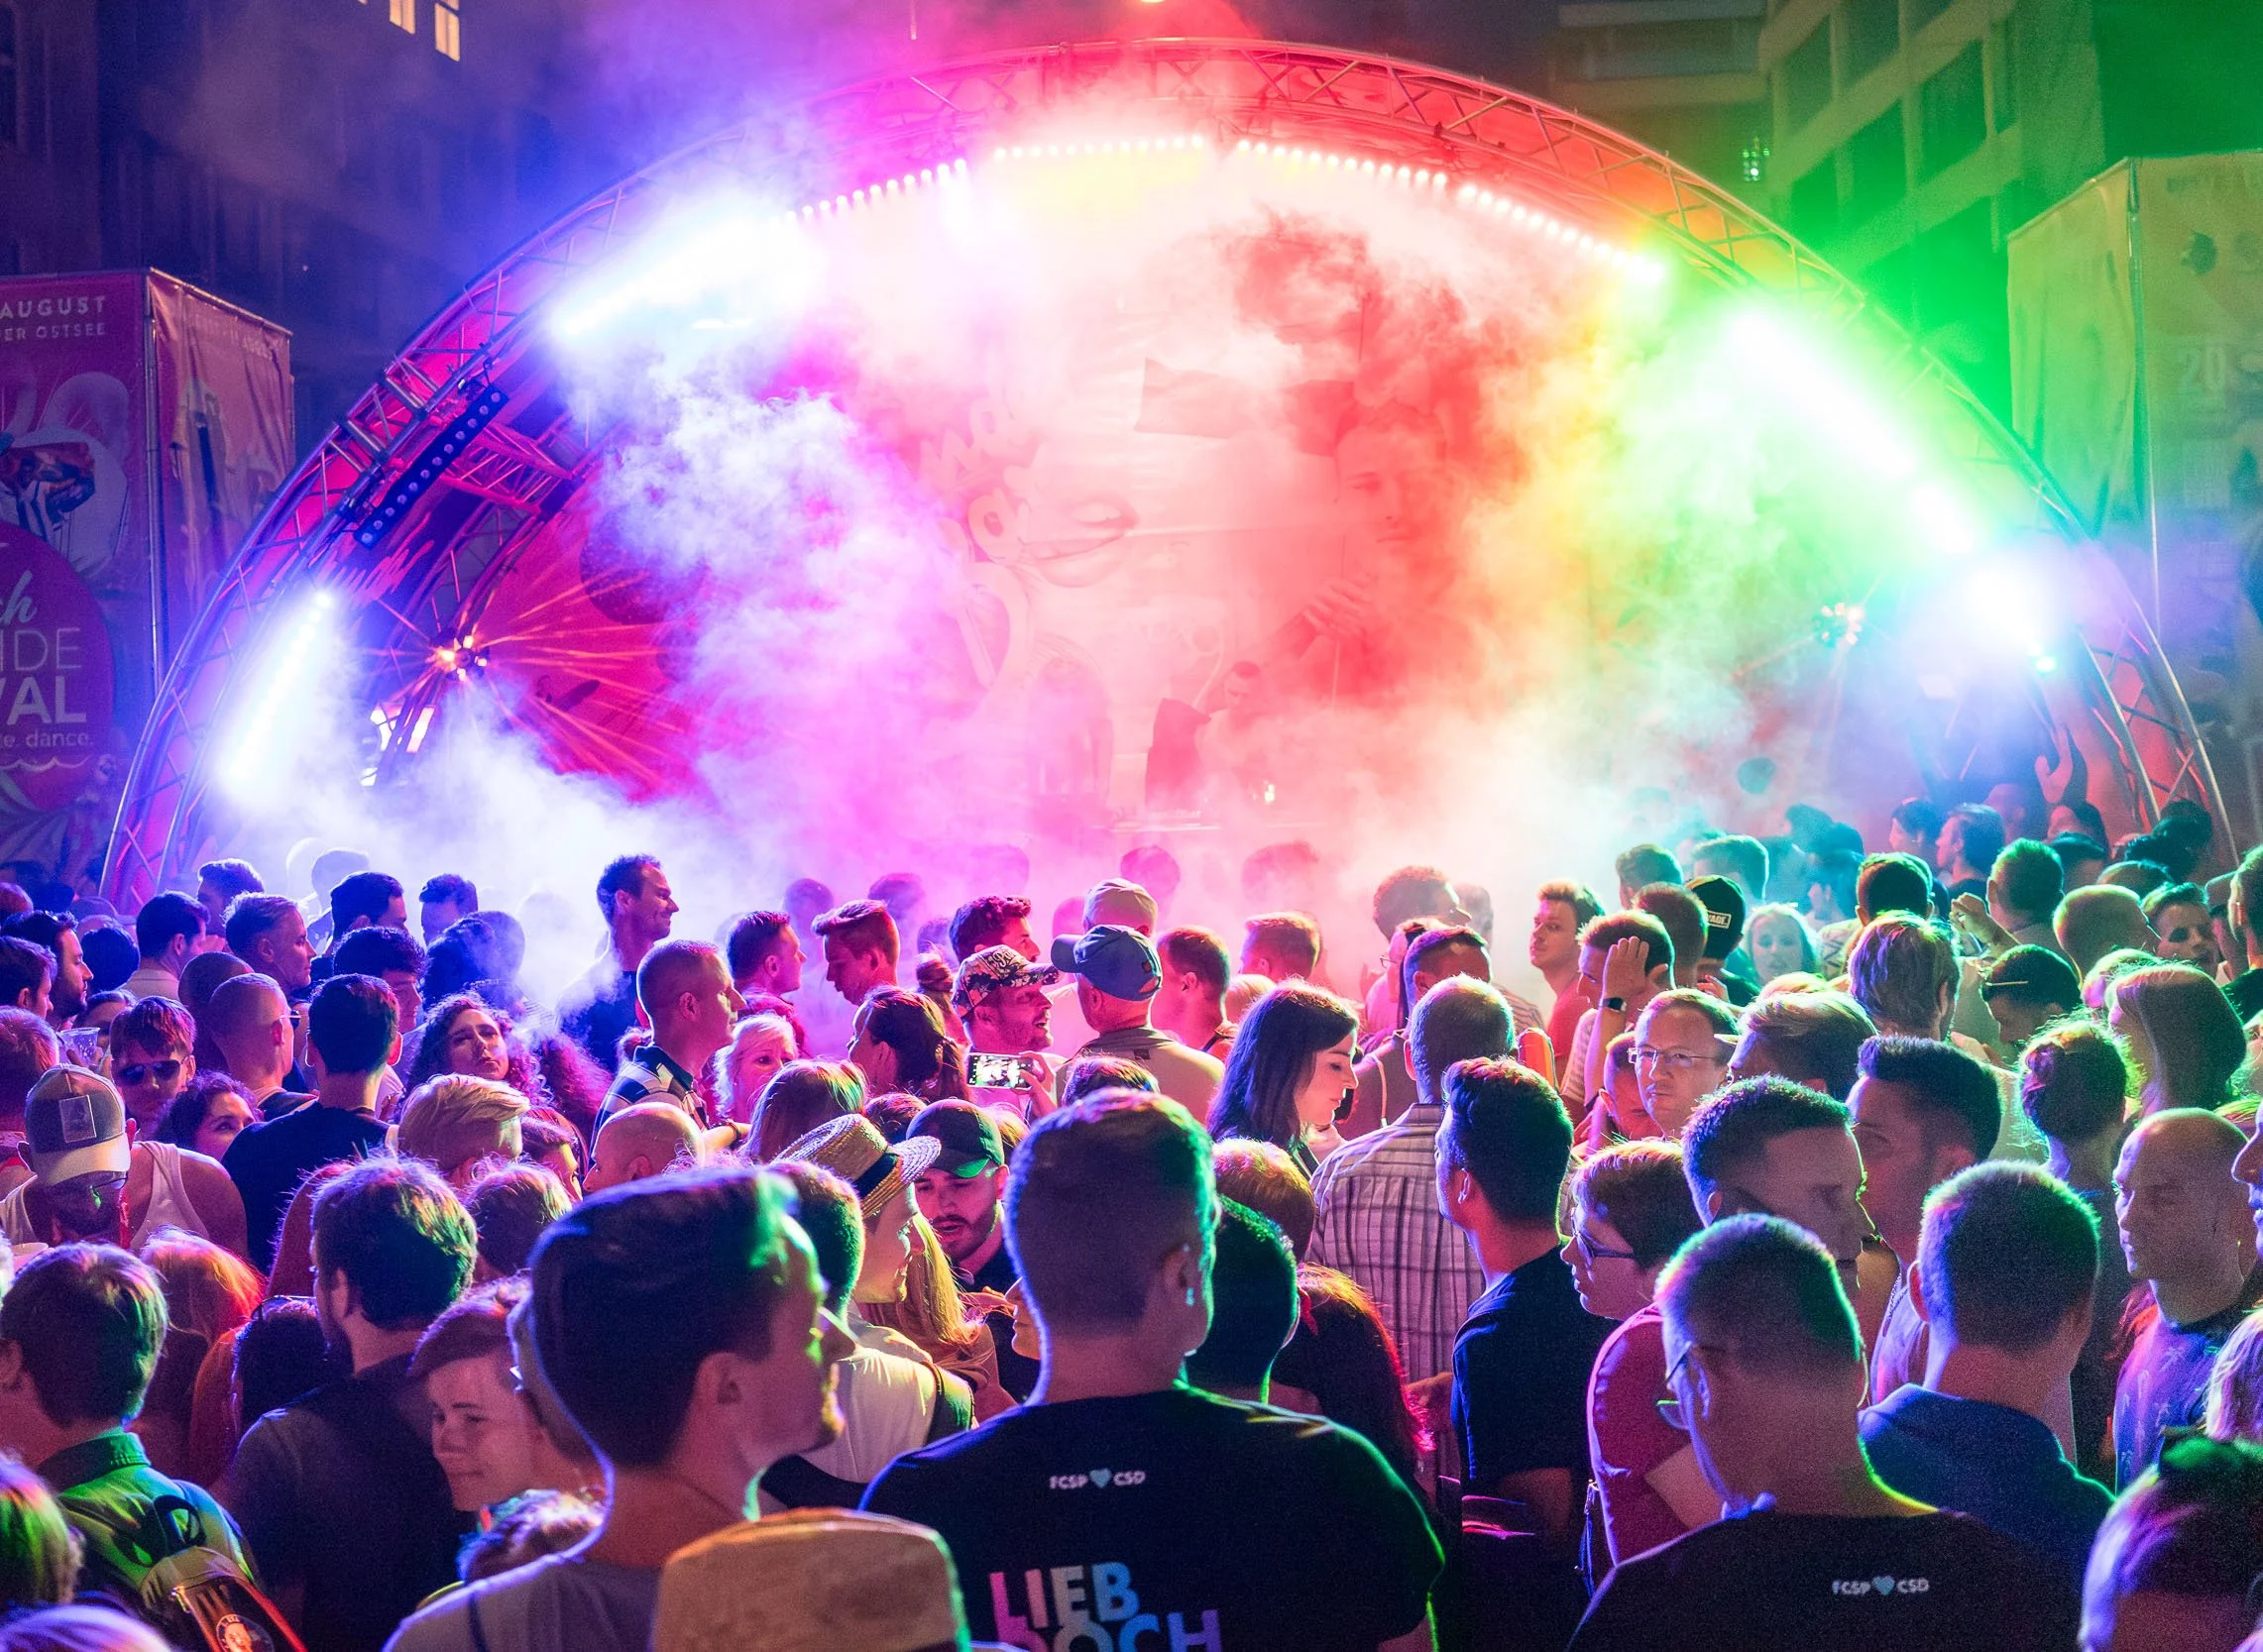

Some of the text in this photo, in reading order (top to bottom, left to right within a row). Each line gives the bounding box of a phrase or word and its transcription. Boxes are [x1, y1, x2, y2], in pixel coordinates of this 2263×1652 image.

[0, 295, 106, 319] AUGUST
[0, 321, 106, 342] ER OSTSEE
[0, 570, 38, 625] h
[0, 675, 87, 725] AL
[1113, 1470, 1146, 1486] CSD
[989, 1561, 1141, 1628] LIEB
